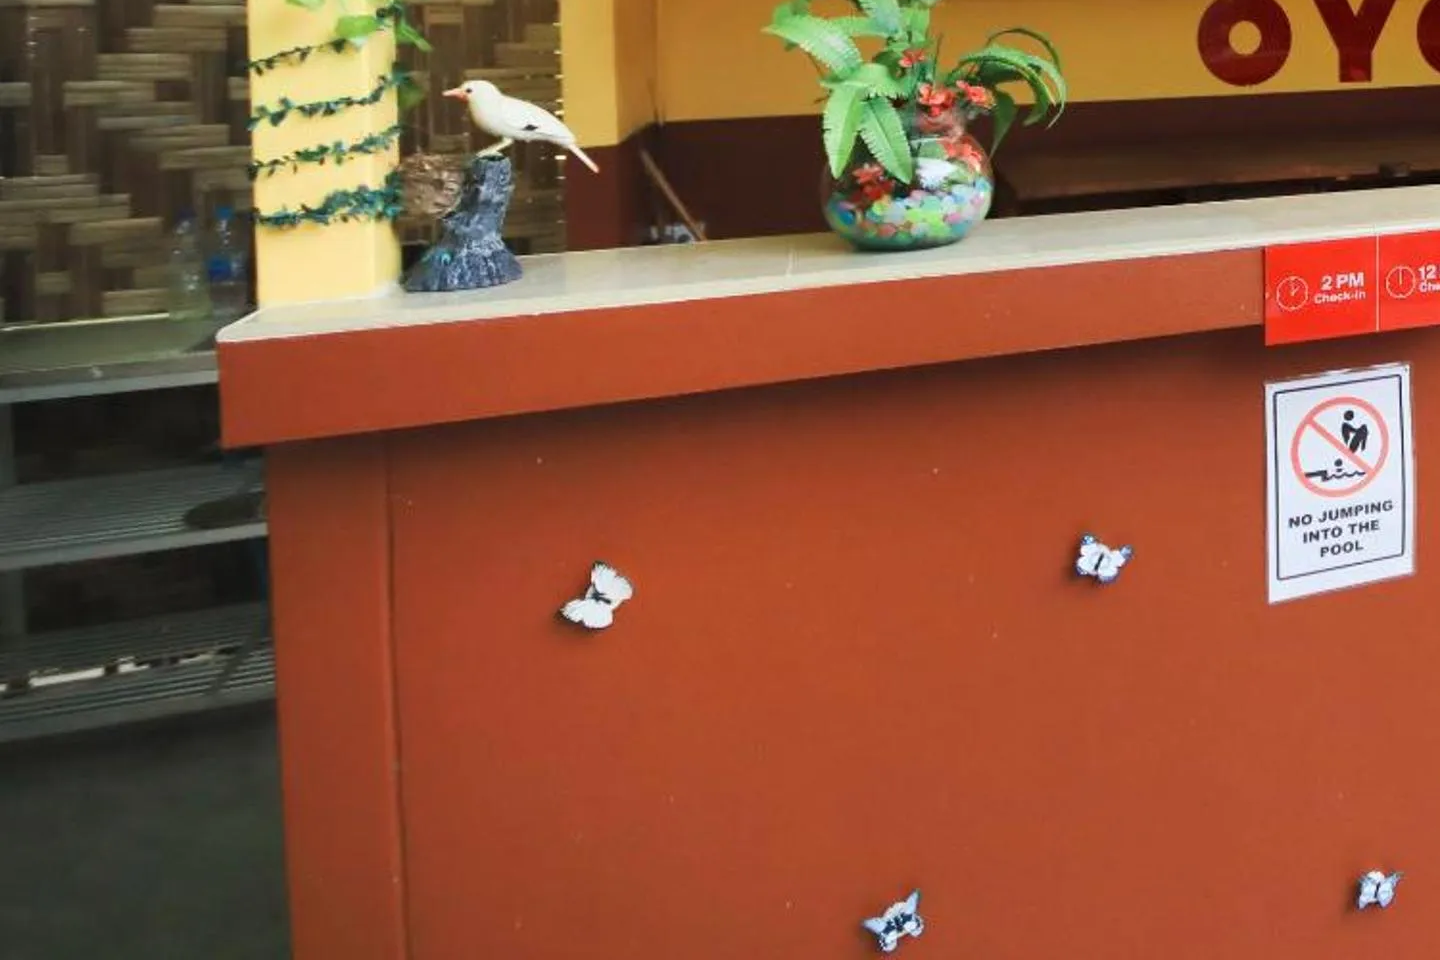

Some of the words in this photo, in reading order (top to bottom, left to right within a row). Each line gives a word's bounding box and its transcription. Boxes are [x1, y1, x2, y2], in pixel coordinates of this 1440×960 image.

[1322, 276, 1332, 290] 2
[1336, 271, 1364, 289] PM
[1419, 266, 1436, 279] 12
[1315, 290, 1366, 304] Check-in
[1289, 514, 1312, 528] NO
[1319, 500, 1393, 522] JUMPING
[1303, 526, 1343, 543] INTO
[1348, 520, 1379, 536] THE
[1320, 541, 1364, 557] POOL
